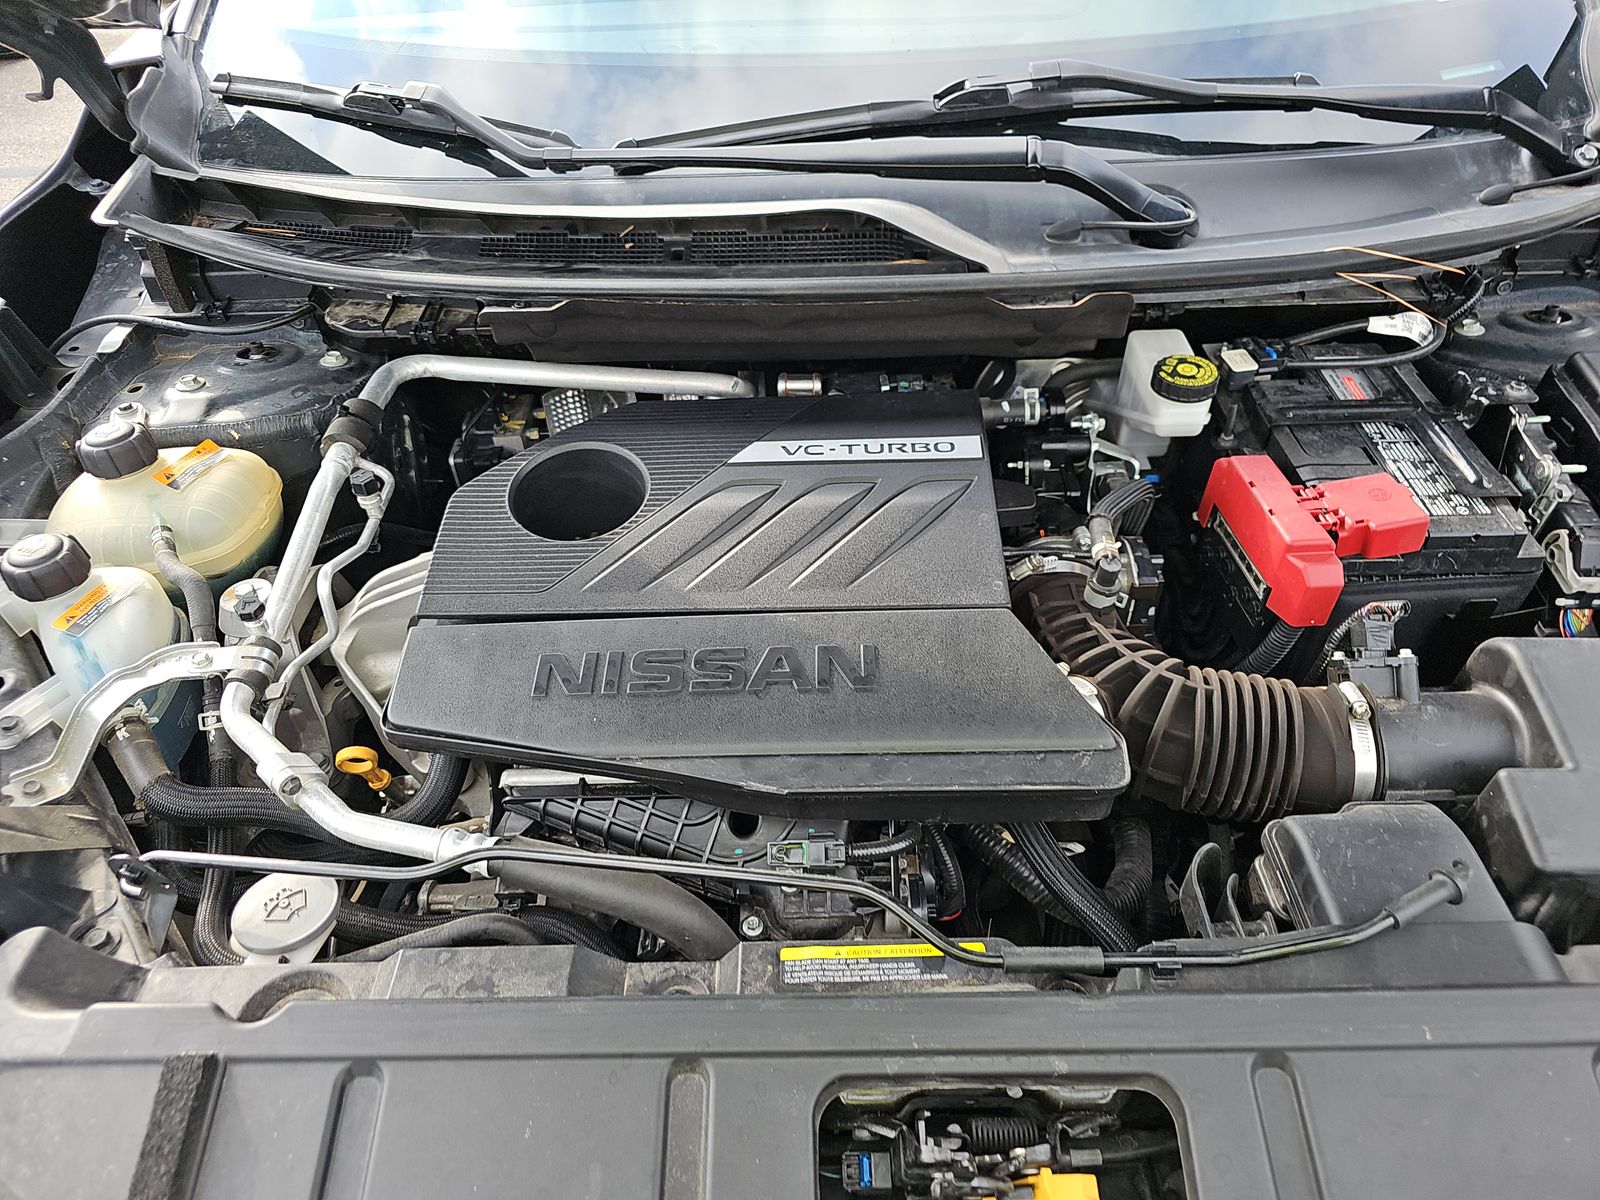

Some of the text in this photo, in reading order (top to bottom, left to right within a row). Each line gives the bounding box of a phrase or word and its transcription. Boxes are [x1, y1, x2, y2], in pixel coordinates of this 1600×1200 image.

[780, 441, 956, 456] VC-TURBO
[531, 644, 878, 698] NISSAN
[846, 949, 881, 957] CAUTION
